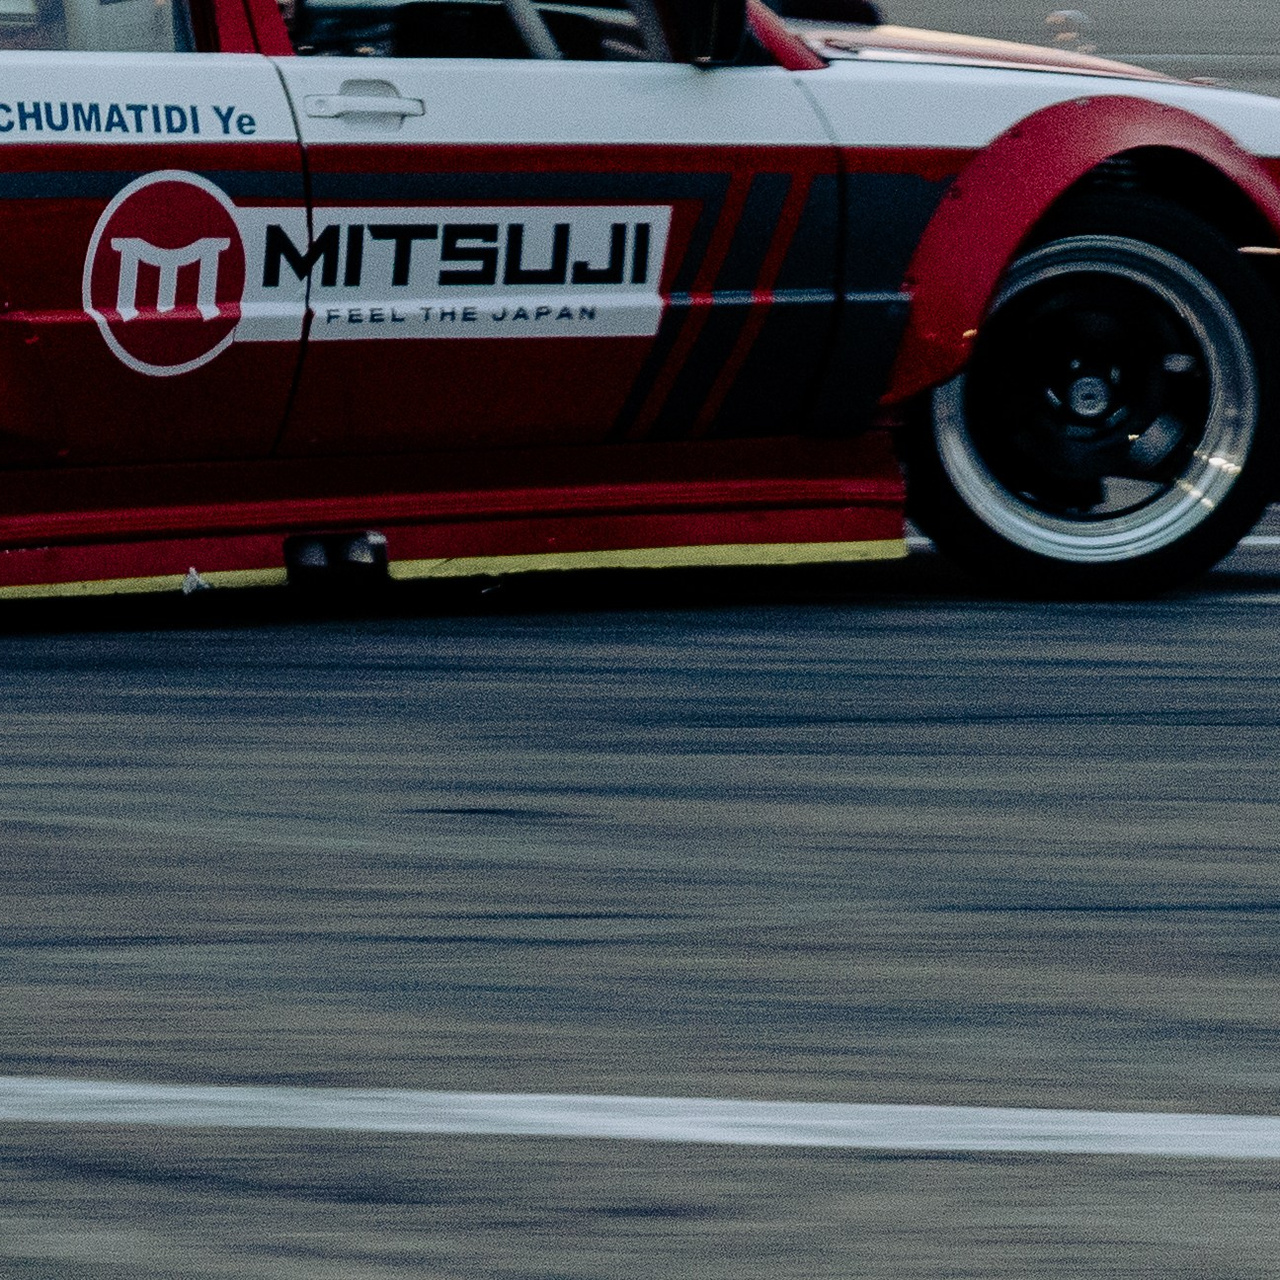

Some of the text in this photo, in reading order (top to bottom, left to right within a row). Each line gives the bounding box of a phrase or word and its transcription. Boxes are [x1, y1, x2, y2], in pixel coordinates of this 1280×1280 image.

[213, 105, 256, 135] Ye
[262, 222, 651, 287] MITSUJI
[326, 306, 598, 324] FEEL THE JAPAN
